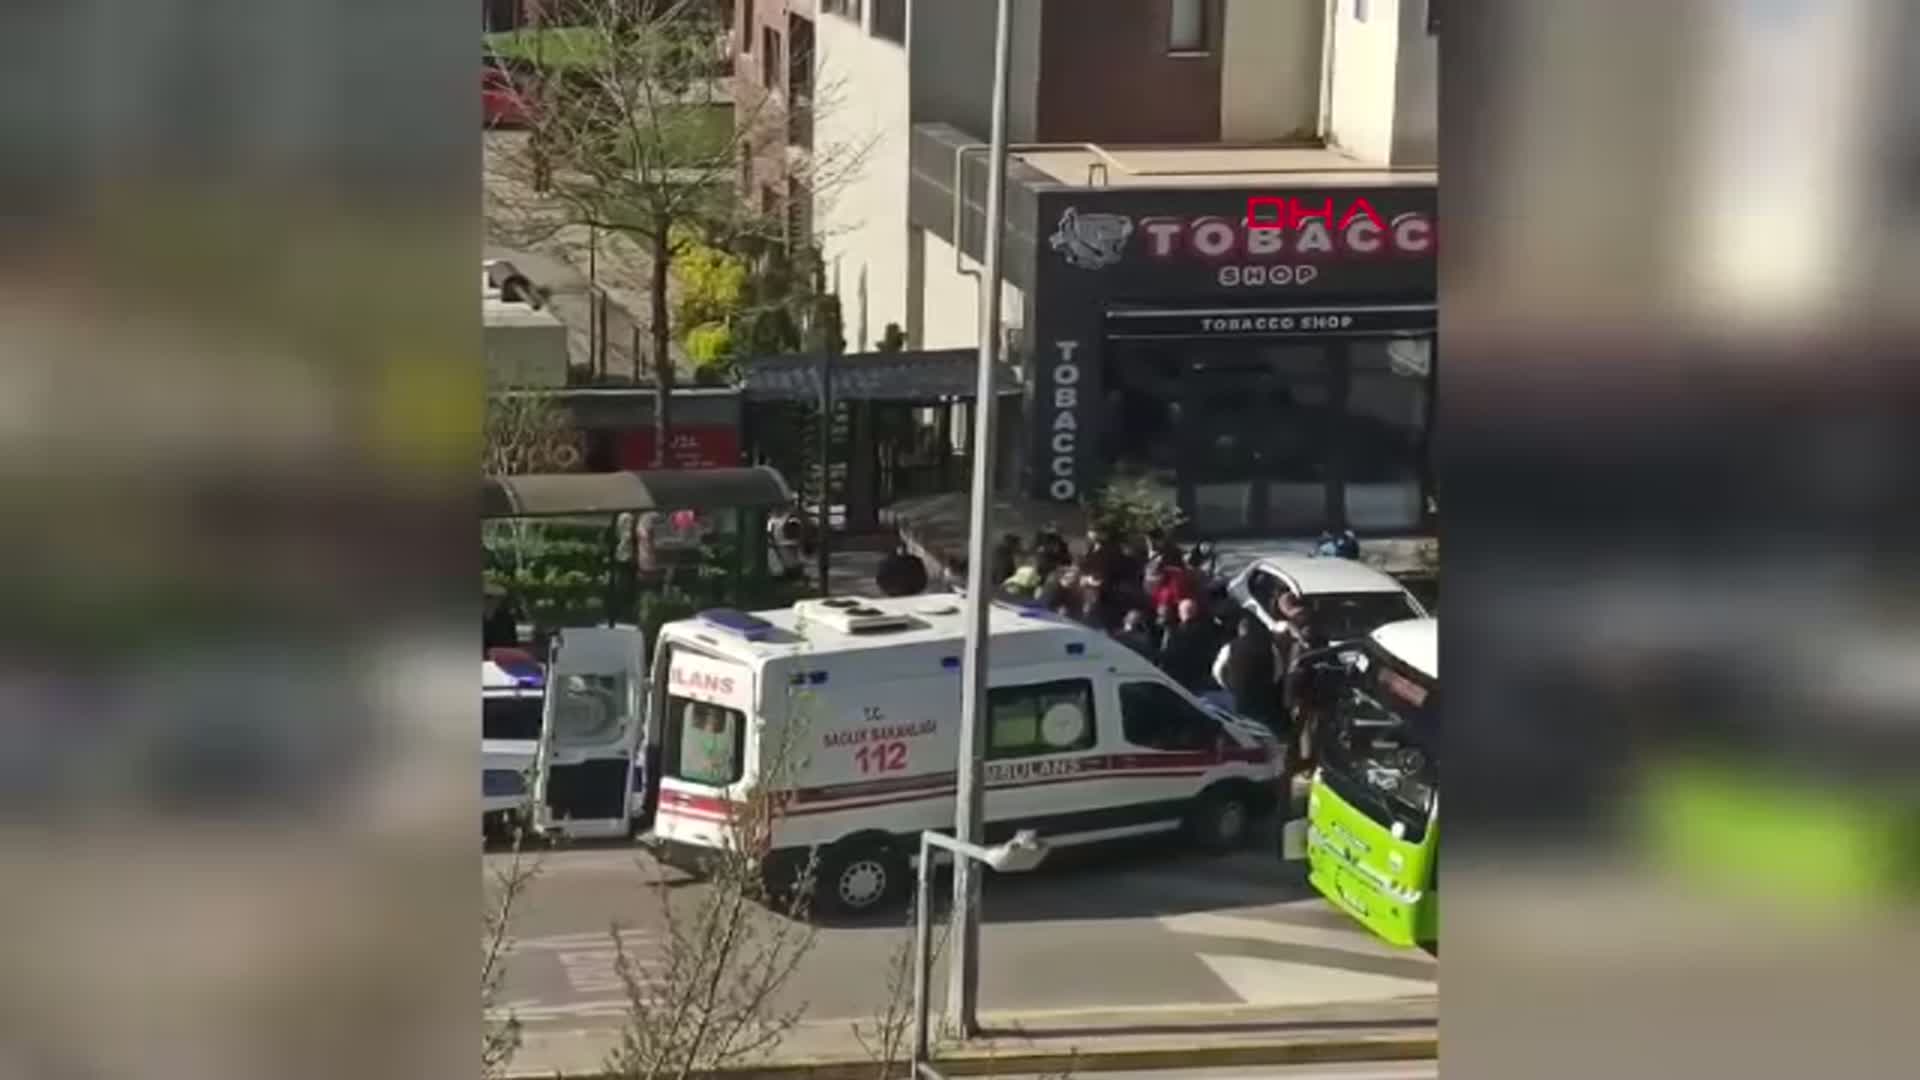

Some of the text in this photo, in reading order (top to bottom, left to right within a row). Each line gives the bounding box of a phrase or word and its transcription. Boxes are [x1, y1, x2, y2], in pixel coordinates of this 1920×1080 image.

[1217, 264, 1318, 287] SHOP
[1201, 316, 1353, 331] TOBACCO SHOP
[1050, 340, 1080, 499] TOBACCO
[855, 742, 907, 773] 112
